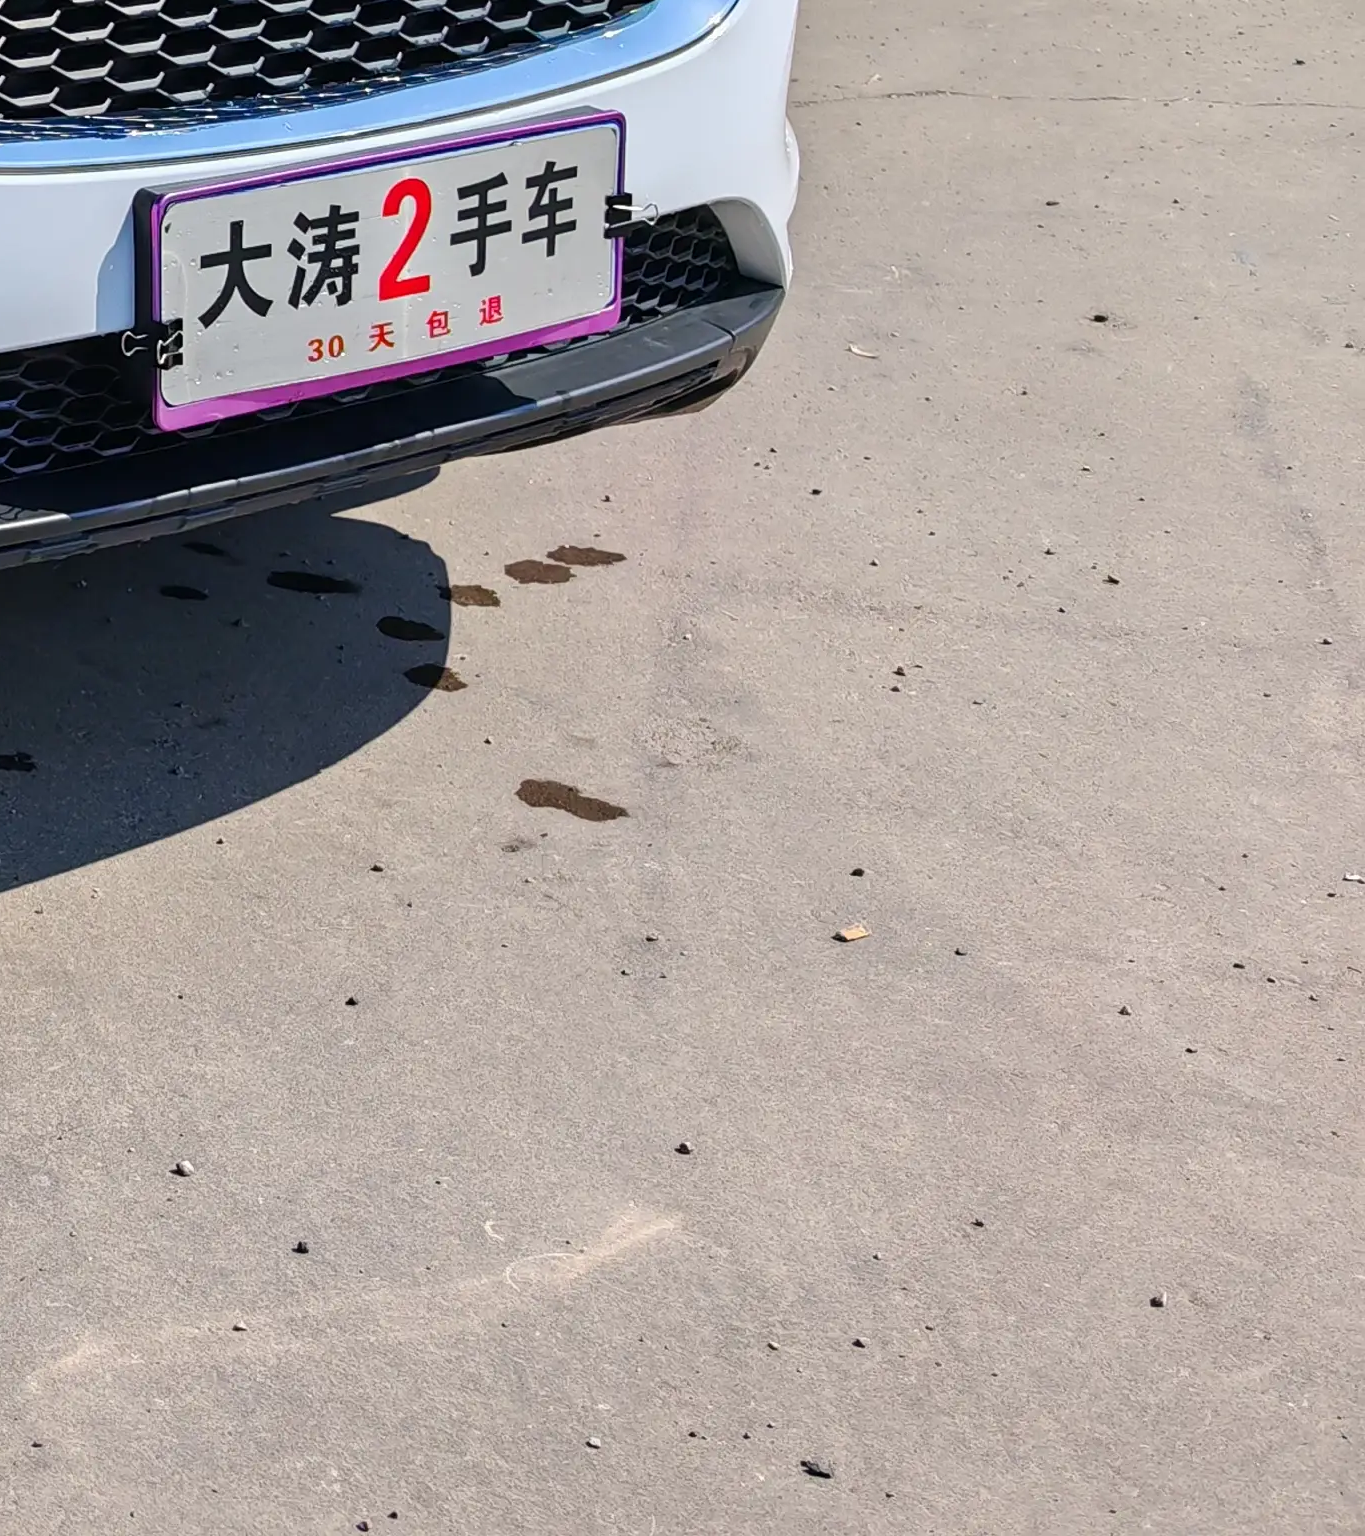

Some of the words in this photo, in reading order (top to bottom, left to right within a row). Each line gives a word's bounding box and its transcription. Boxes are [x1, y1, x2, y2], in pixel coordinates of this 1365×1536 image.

[196, 161, 579, 328] 大涛2手车
[307, 294, 505, 363] 30天包退
